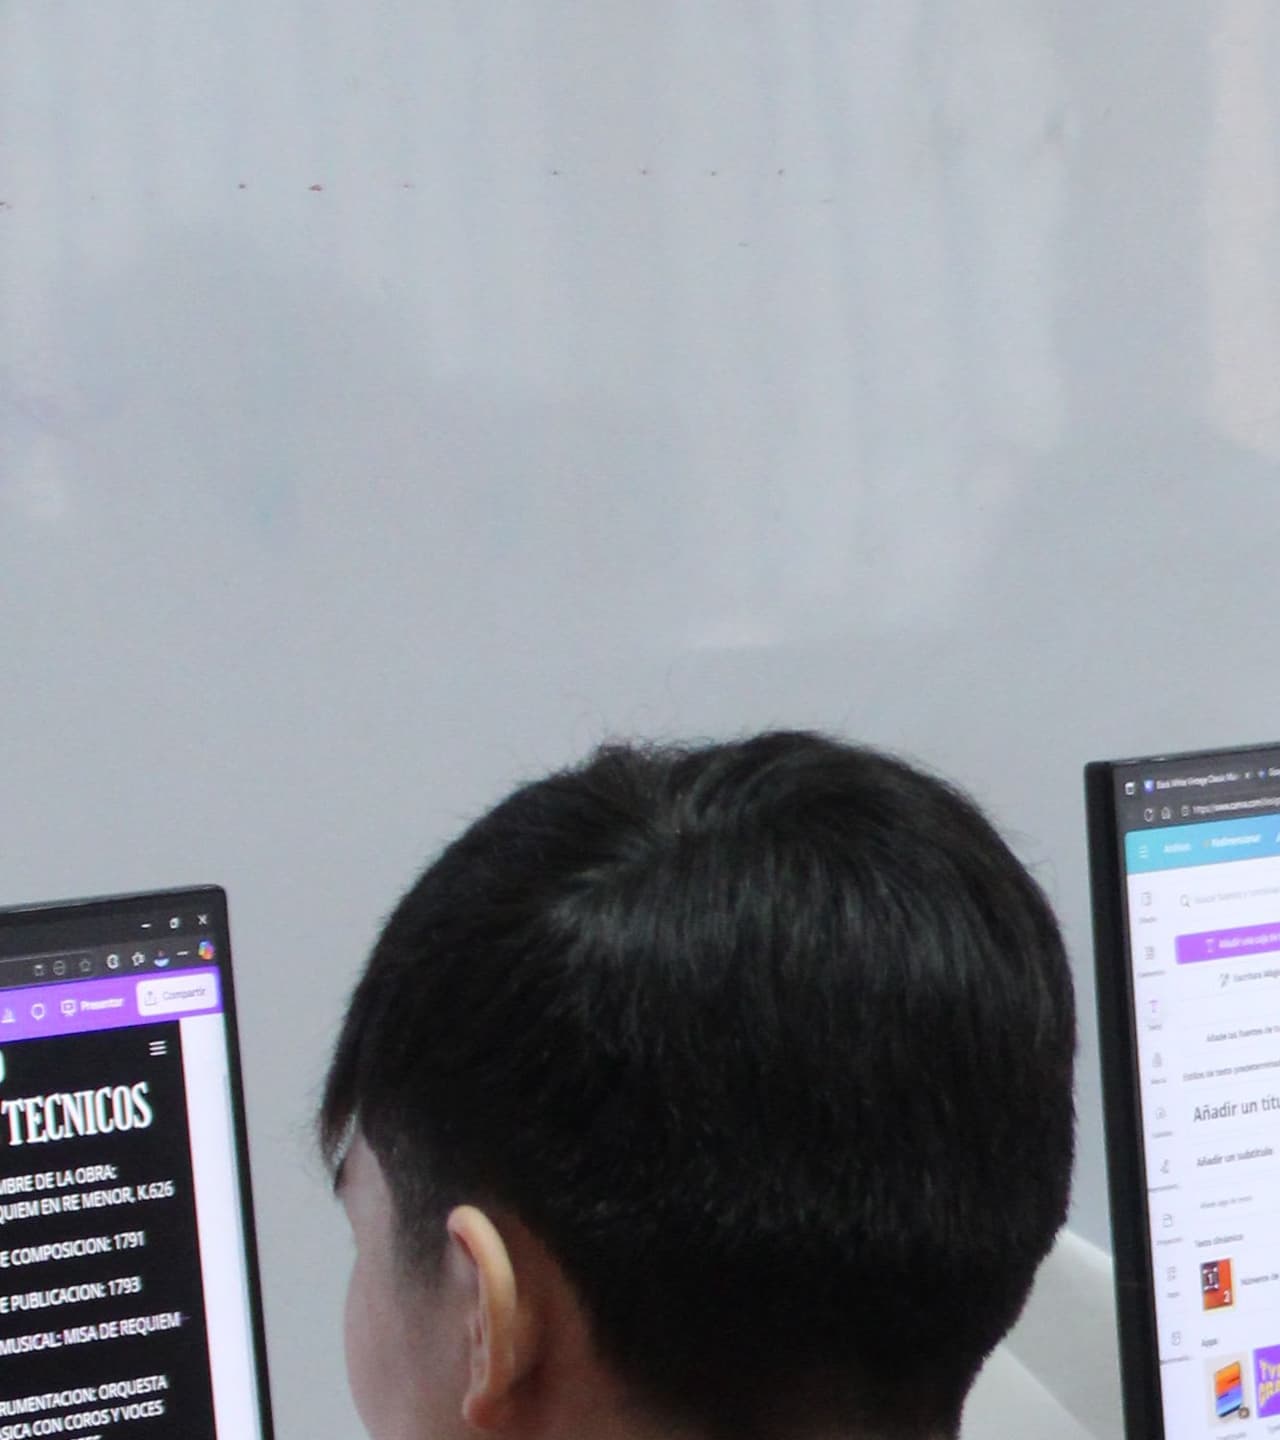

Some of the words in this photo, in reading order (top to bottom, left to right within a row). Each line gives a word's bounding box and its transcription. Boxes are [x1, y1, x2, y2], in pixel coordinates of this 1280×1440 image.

[80, 998, 124, 1012] Presentar
[163, 986, 206, 1003] Compartir
[1, 1082, 153, 1146] TECNICOS
[1193, 1103, 1237, 1122] Añadir
[1241, 1100, 1258, 1115] un
[35, 1172, 55, 1190] DE
[56, 1170, 74, 1187] LA
[75, 1164, 118, 1185] OBRA:
[1197, 1154, 1223, 1167] Añadir
[1225, 1153, 1235, 1163] un
[41, 1198, 61, 1215] EN
[63, 1195, 81, 1211] RE
[82, 1187, 136, 1209] MENOR,
[137, 1181, 175, 1201] K.626
[11, 1236, 112, 1265] COMPOSICION:
[114, 1231, 146, 1250] 1791
[11, 1283, 106, 1312] PUBLICACION:
[108, 1276, 142, 1295] 1793
[1223, 1290, 1231, 1304] 2
[0, 1332, 63, 1356] MUSICAL:
[64, 1326, 98, 1345] MISA
[99, 1321, 119, 1339] DE
[120, 1312, 181, 1336] REQUIEM
[0, 1387, 97, 1417] RUMENTACION:
[98, 1375, 168, 1399] ORQUESTA
[33, 1417, 63, 1437] CON
[64, 1409, 109, 1431] COROS
[110, 1408, 120, 1422] Y
[120, 1400, 164, 1420] VOCES
